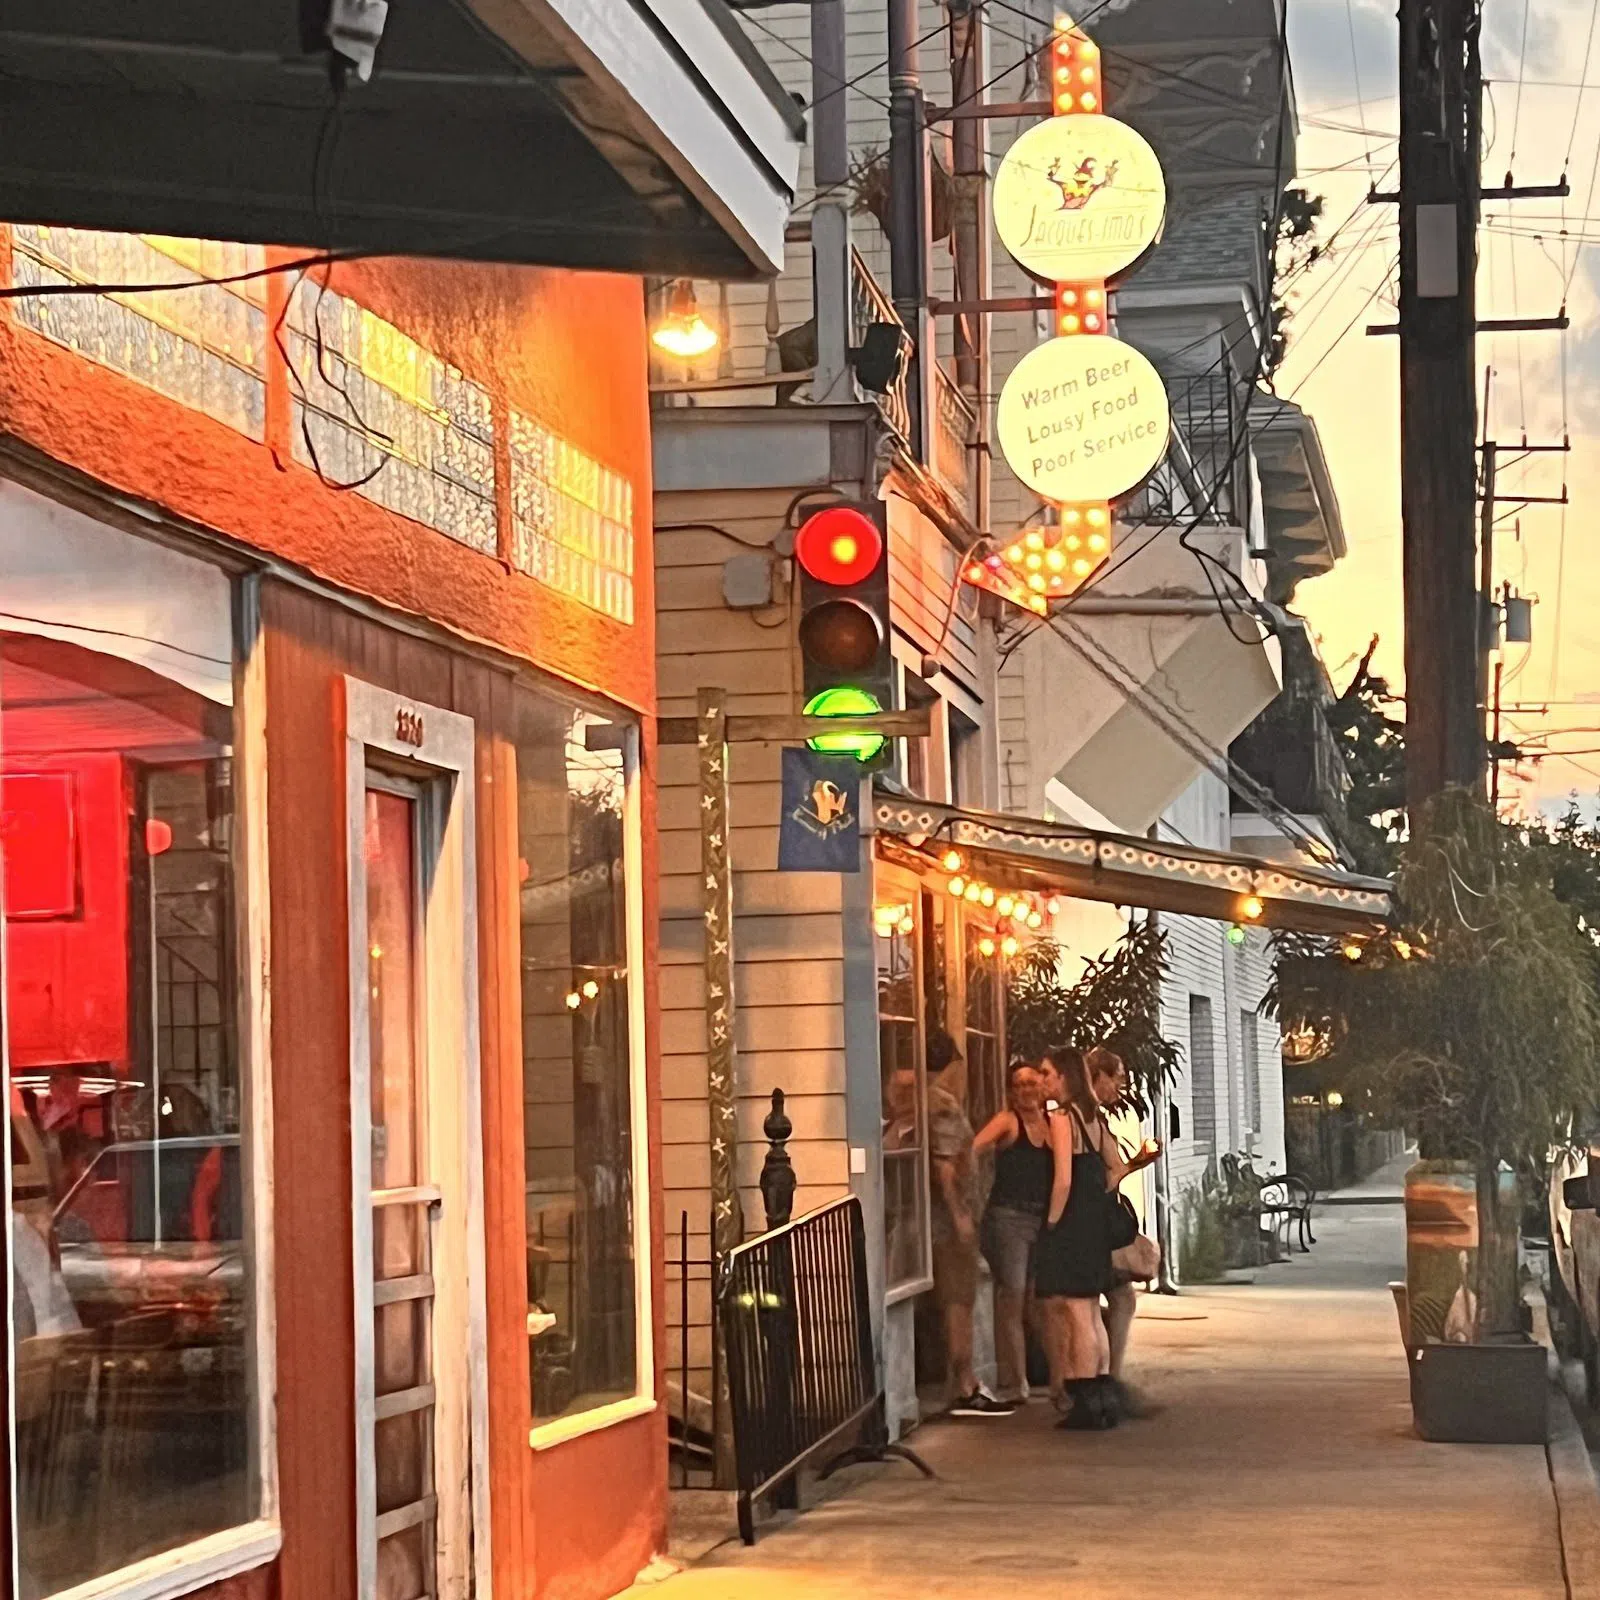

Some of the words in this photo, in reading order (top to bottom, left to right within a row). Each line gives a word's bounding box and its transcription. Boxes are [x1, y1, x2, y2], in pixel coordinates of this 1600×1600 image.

[1021, 381, 1080, 409] Warm
[1085, 359, 1132, 388] Beer
[1027, 413, 1085, 444] Lousy
[1091, 386, 1139, 421] Food
[1031, 450, 1078, 477] Poor
[1083, 421, 1158, 458] Service
